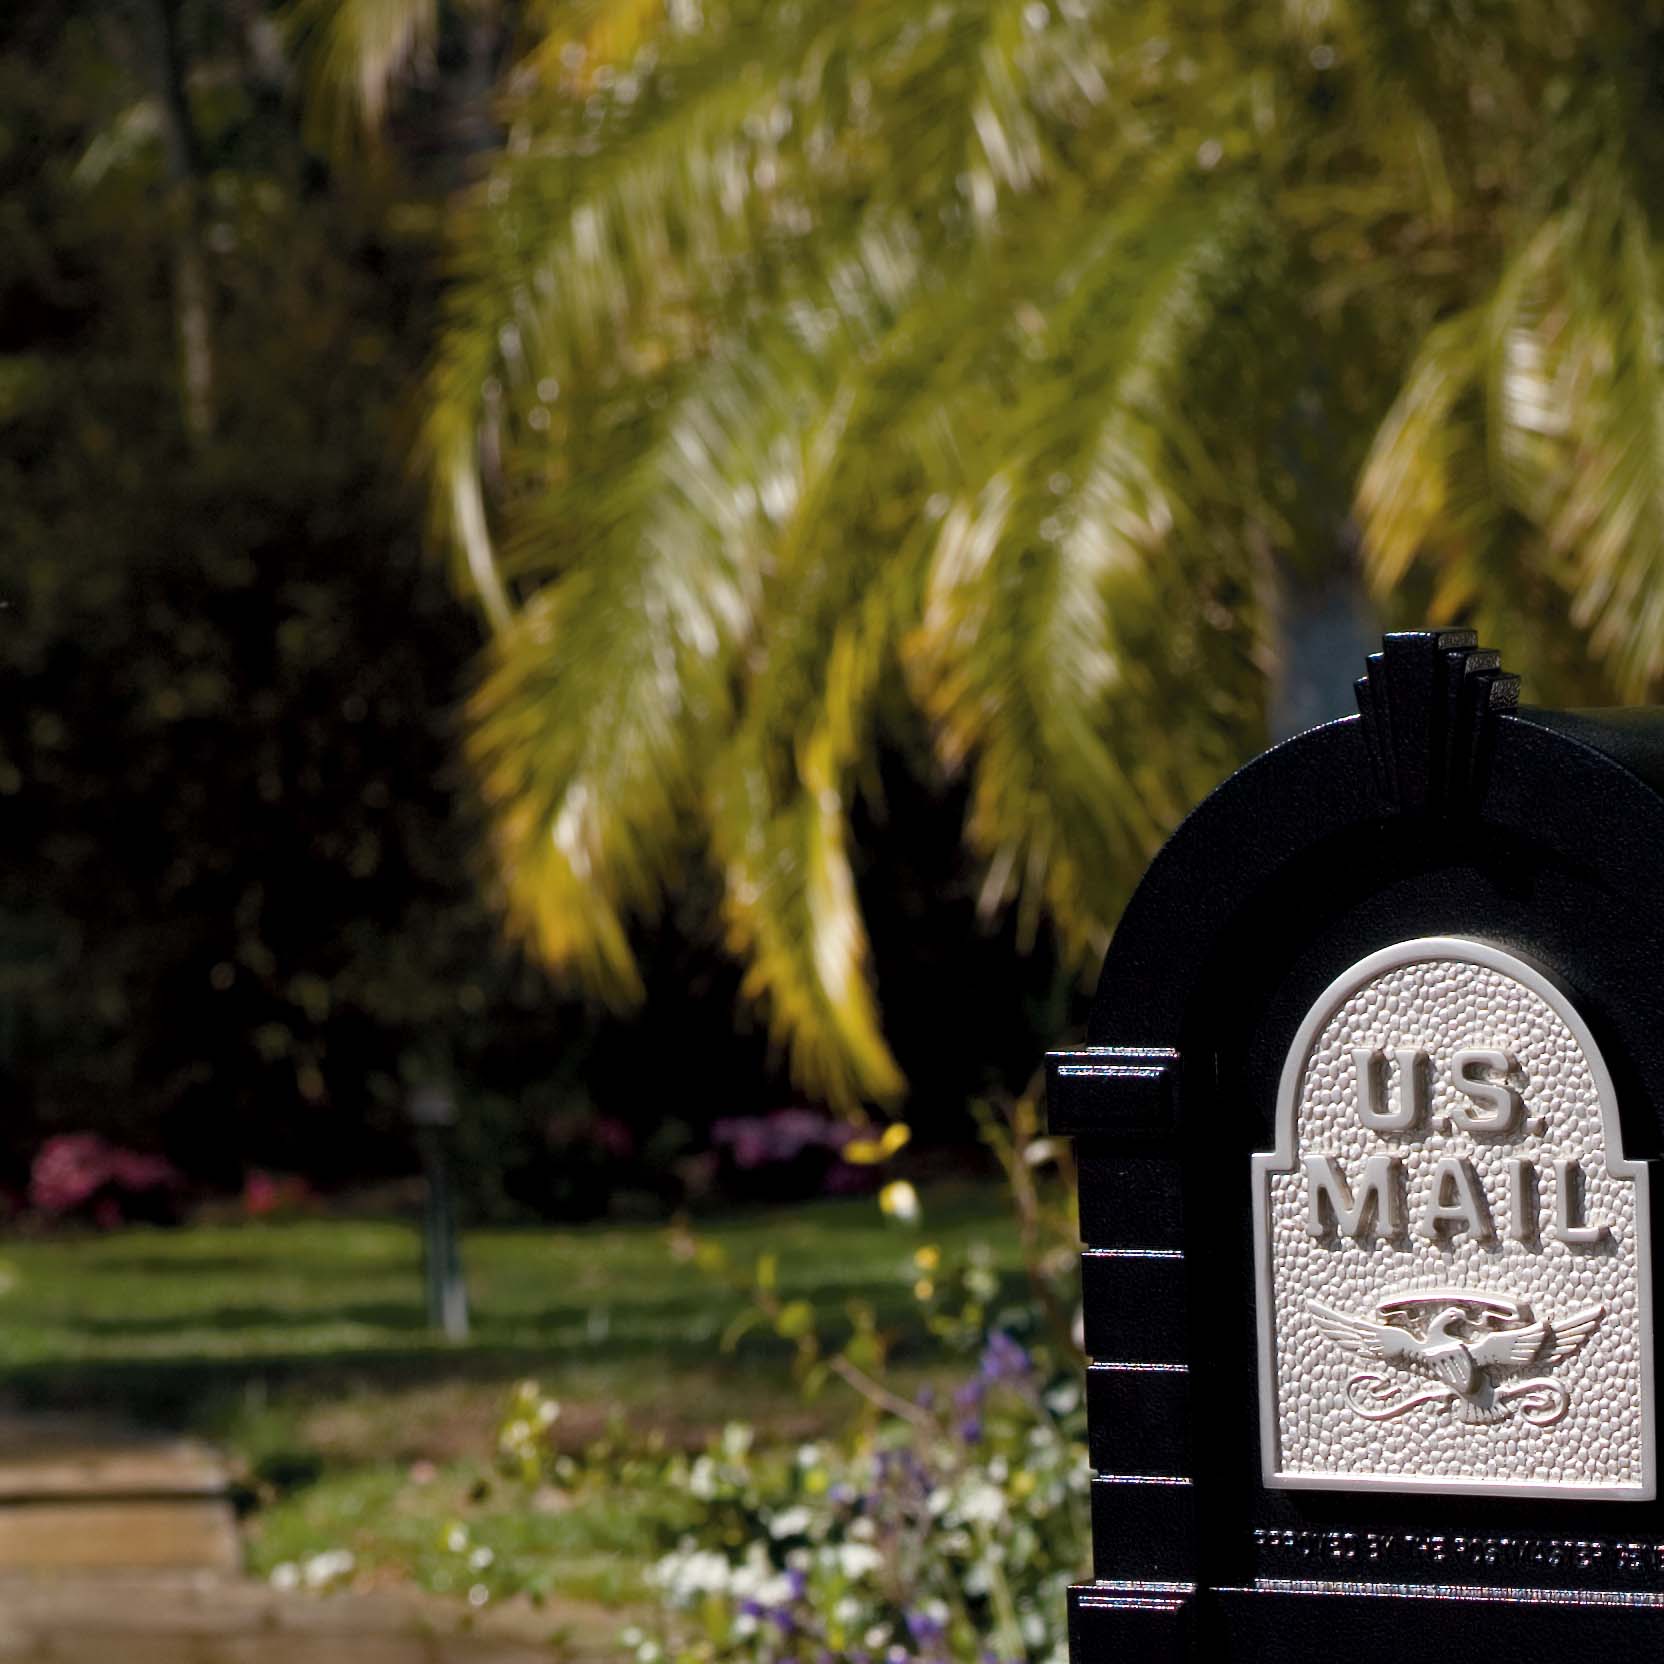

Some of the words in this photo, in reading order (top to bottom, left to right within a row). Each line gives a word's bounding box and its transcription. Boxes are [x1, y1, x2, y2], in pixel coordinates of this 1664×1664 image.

[1350, 1047, 1544, 1133] U.S.
[1303, 1154, 1613, 1244] MAIL
[1252, 1529, 1358, 1558] PPROVED
[1367, 1532, 1394, 1560] BY
[1404, 1534, 1446, 1562] THE
[1455, 1536, 1603, 1568] POSTMASTER
